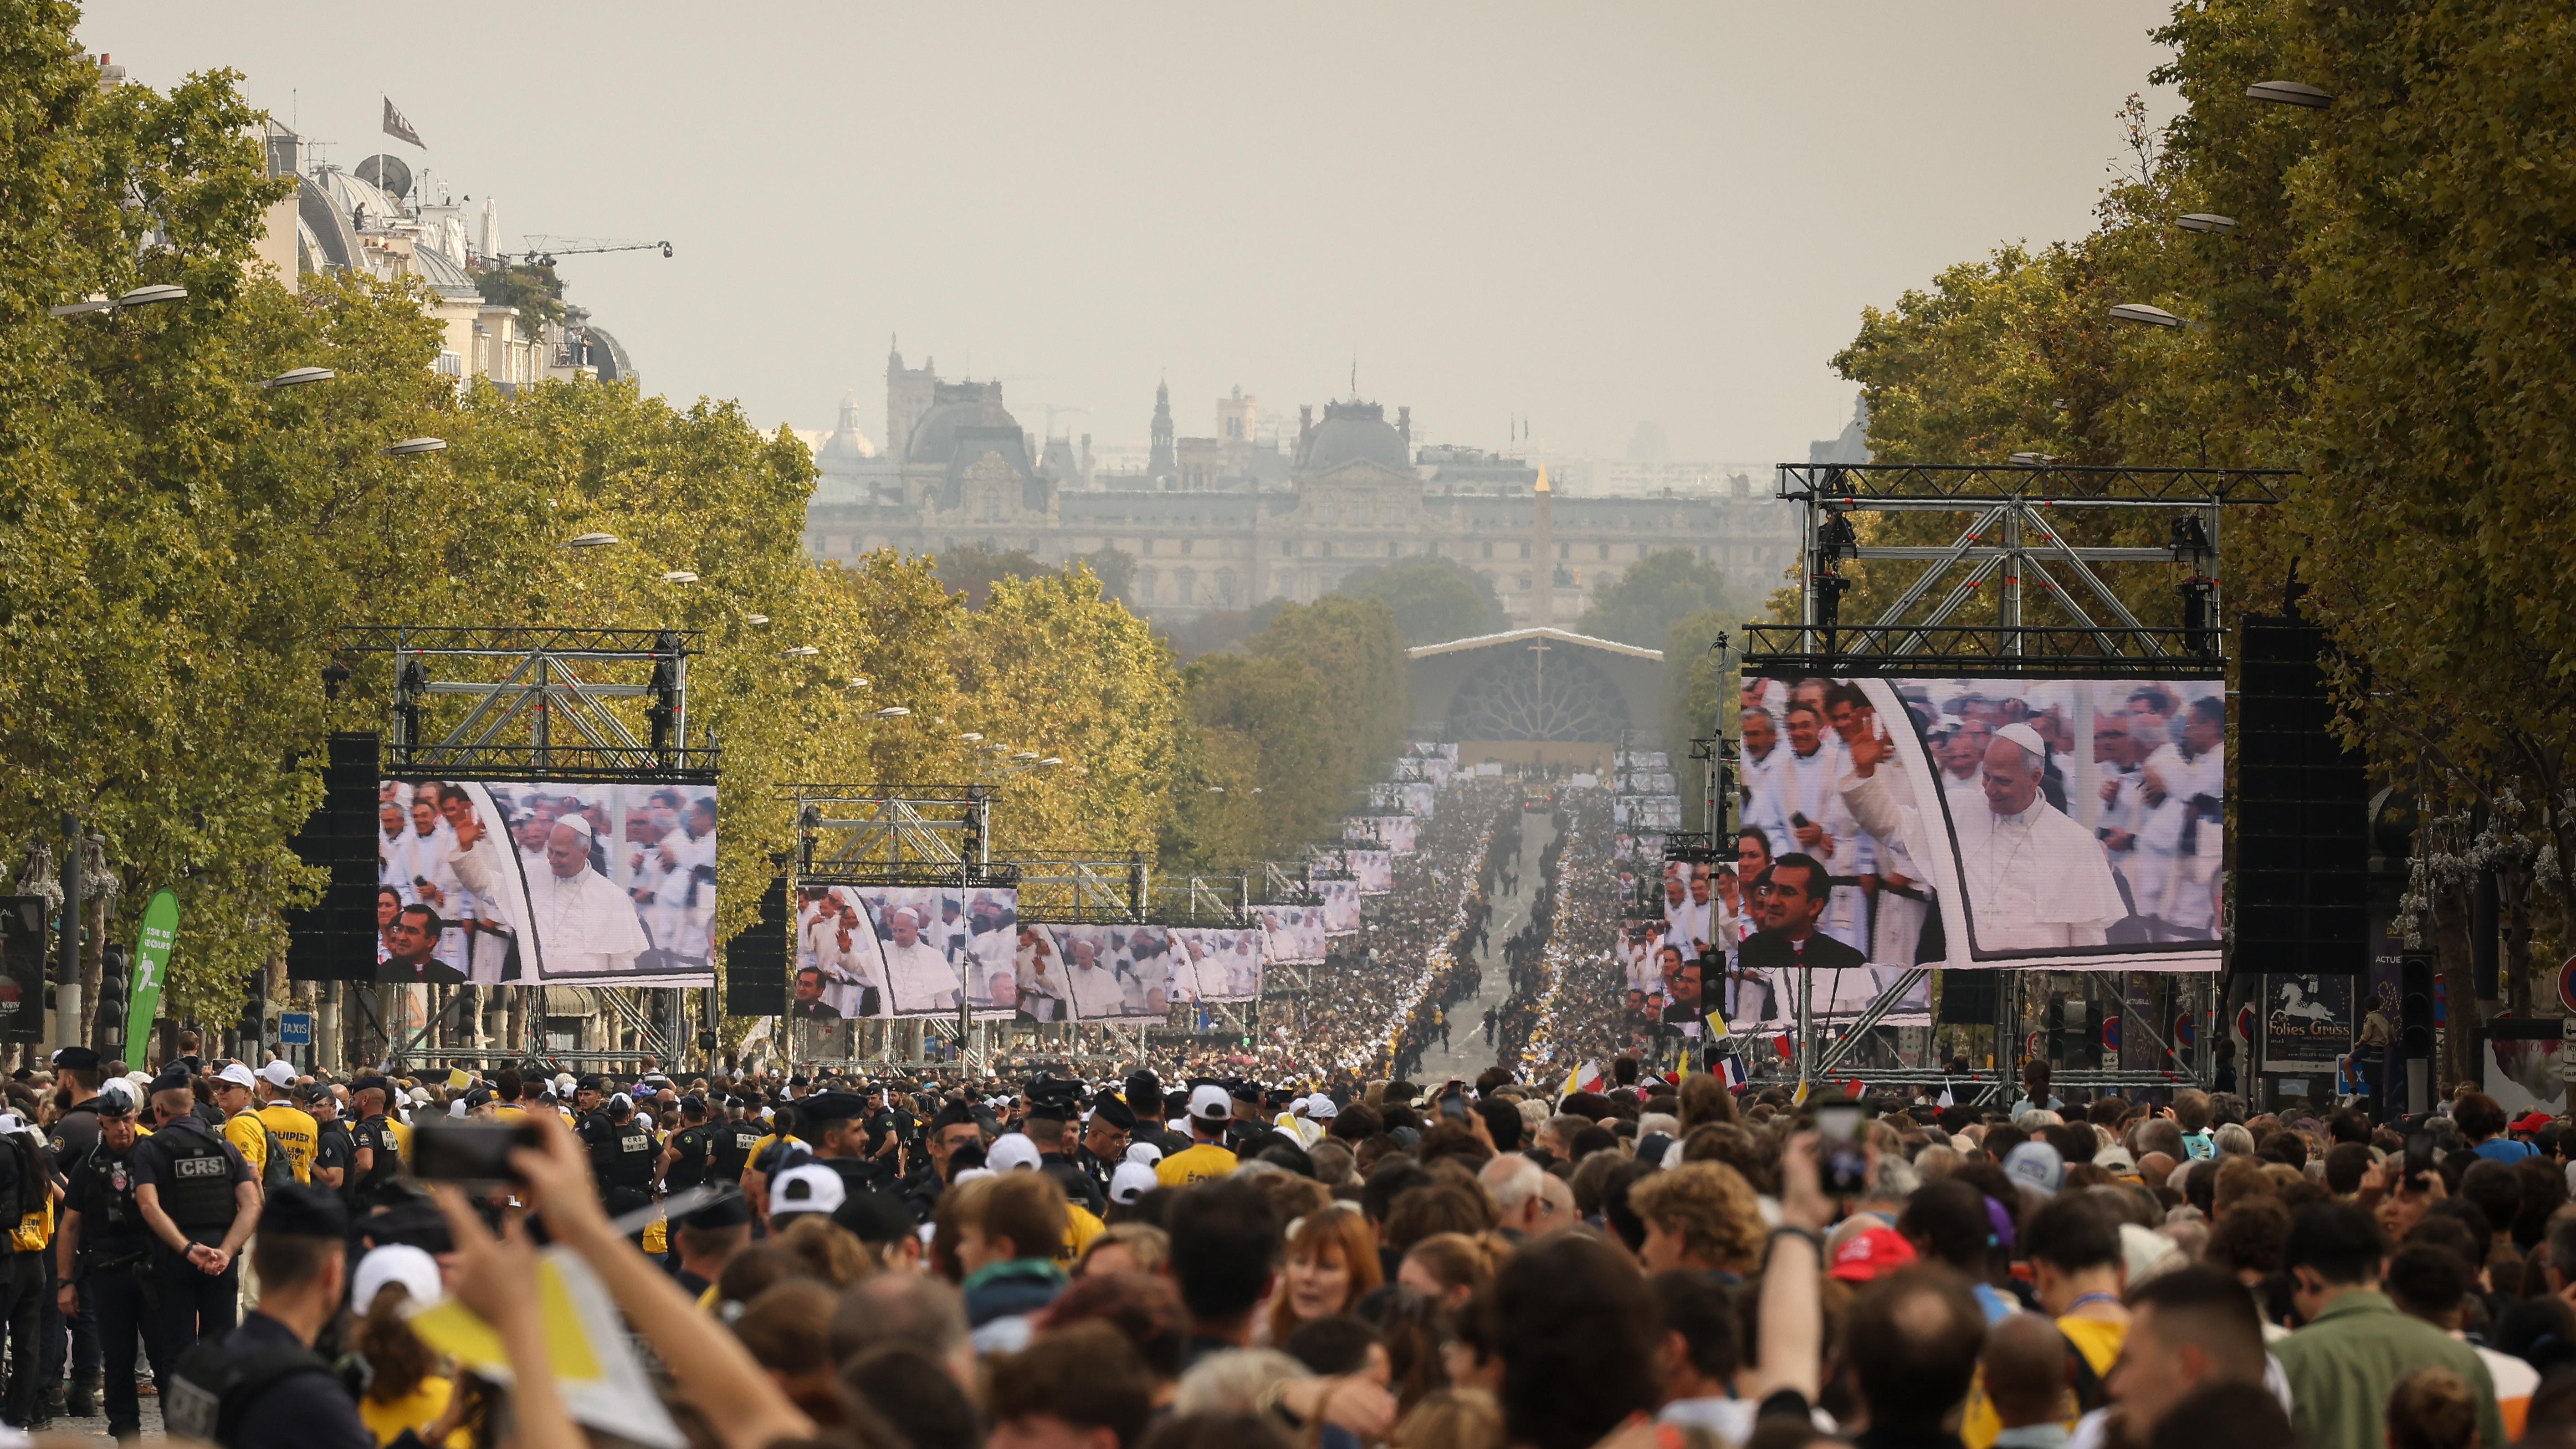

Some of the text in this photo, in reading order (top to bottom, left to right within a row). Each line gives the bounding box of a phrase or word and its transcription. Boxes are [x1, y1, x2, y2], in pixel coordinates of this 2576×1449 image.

[282, 1023, 307, 1034] TAXIS
[2269, 1020, 2350, 1035] Folies Gruss
[271, 1131, 309, 1143] QUIPIER
[181, 1158, 220, 1175] CRS
